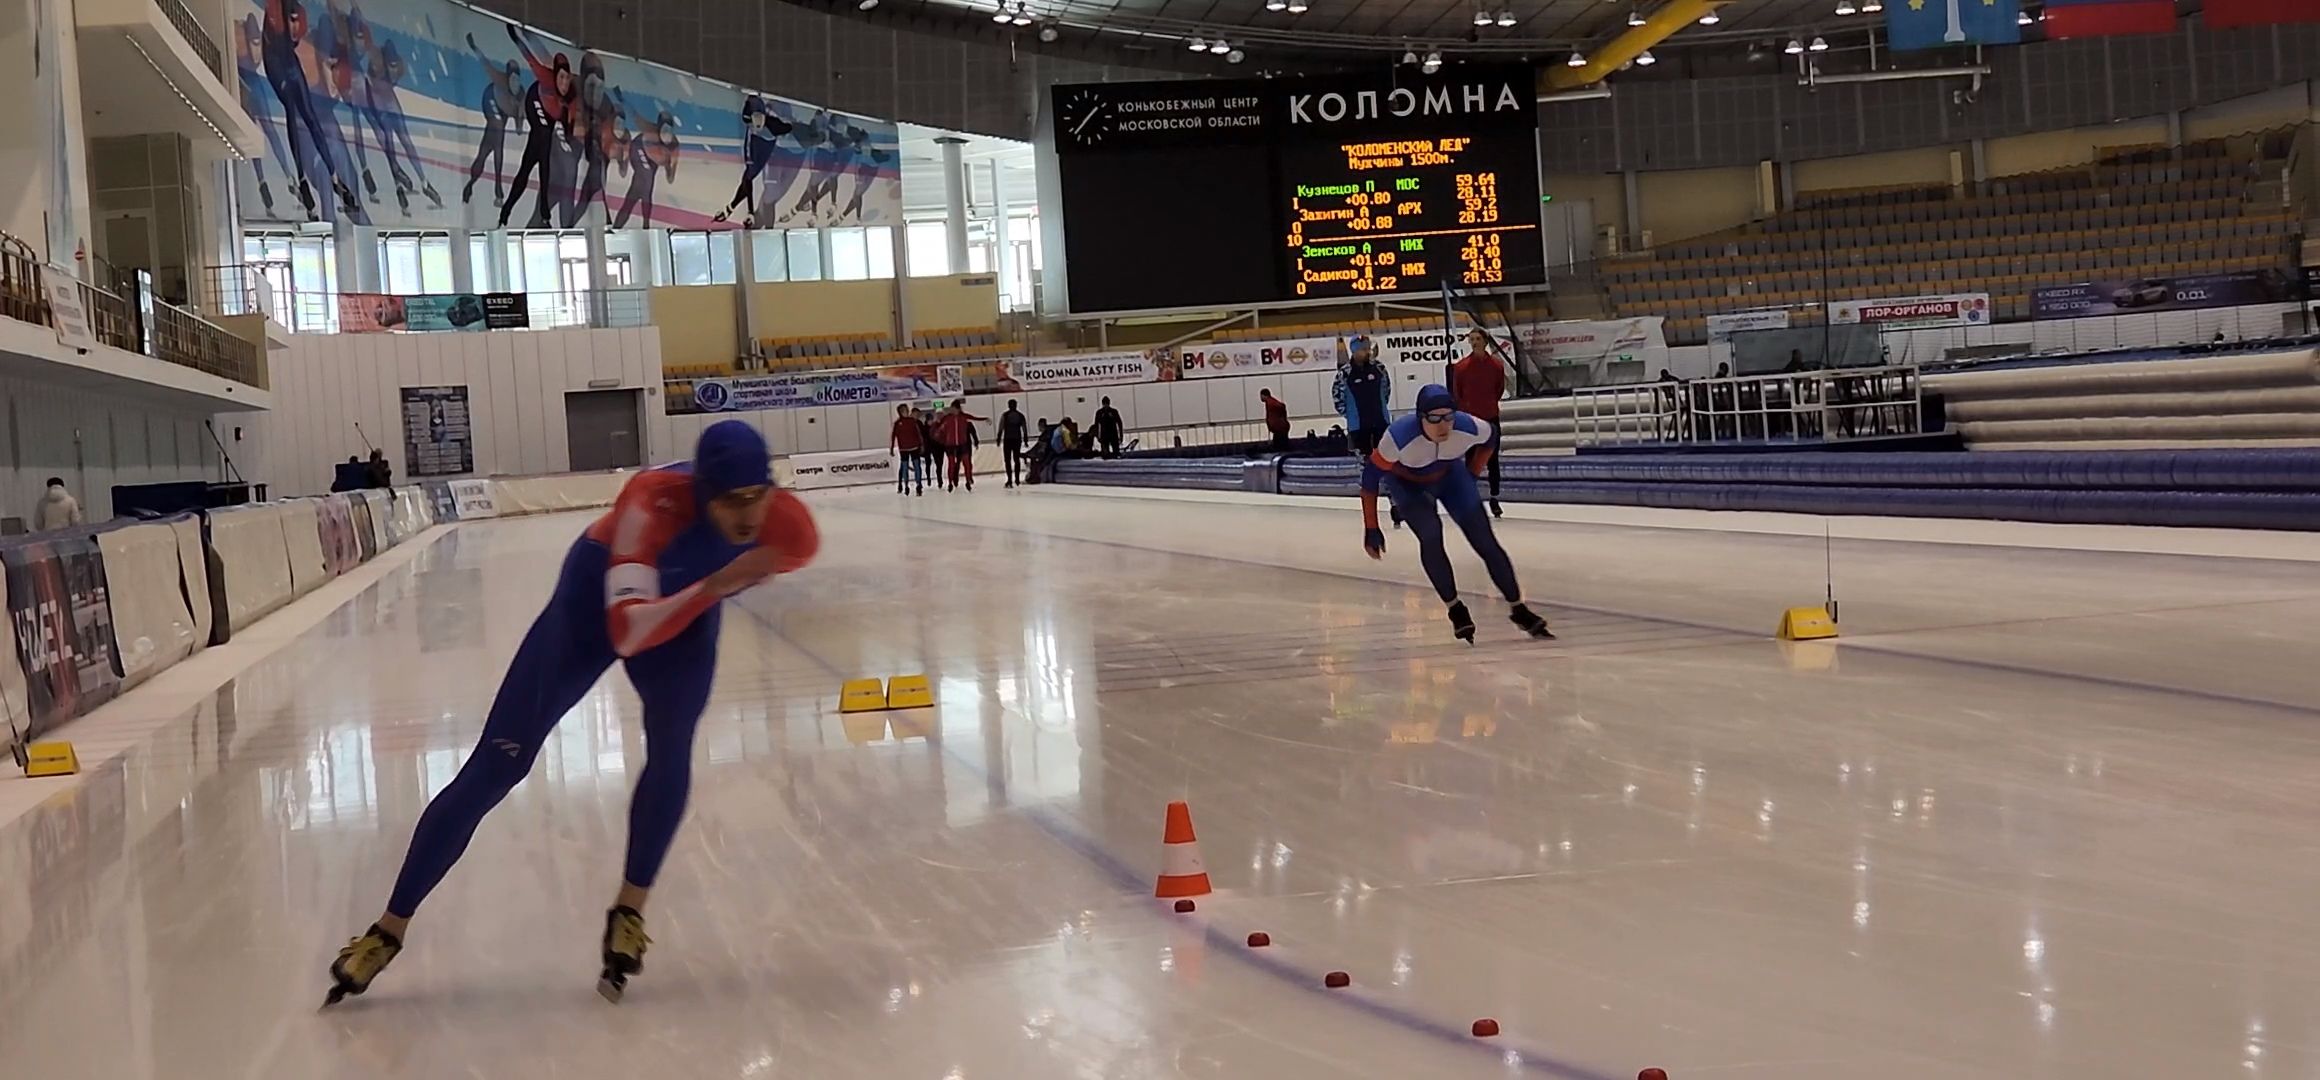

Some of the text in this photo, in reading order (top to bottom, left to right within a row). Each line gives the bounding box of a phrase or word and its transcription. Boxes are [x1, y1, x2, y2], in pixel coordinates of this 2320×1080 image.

[1117, 97, 1259, 113] КОНЬКОБЕЖНЫЙ ЦЕНТР
[1290, 83, 1520, 124] КОЛОМНА
[1118, 115, 1261, 131] МОСКОВСКОЙ ОБЛАСТИ
[1349, 154, 1455, 170] Мужчины 1500м.
[1297, 173, 1496, 197] Кузнецов П МОС 59.64
[1457, 186, 1496, 199] 28.11
[1299, 208, 1354, 222] Зажигин
[1465, 198, 1497, 211] 59.2
[1458, 210, 1498, 223] 28.19
[1287, 234, 1303, 247] 10
[1302, 245, 1356, 258] Земсков
[1400, 238, 1424, 252] НИХ
[1467, 234, 1500, 247] 41.0
[1349, 252, 1395, 267] +01.09
[1461, 246, 1501, 260] 28.40
[1303, 270, 1358, 283] Садиков
[1469, 258, 1502, 271] 41.0
[1351, 276, 1398, 291] +01.22
[1463, 270, 1503, 284] 28.53
[1866, 303, 1953, 318] ЛОР-ОРГАНОВ
[1025, 367, 1080, 381] KOLOMNA
[1082, 364, 1115, 376] TASTY
[1117, 363, 1143, 374] FISH
[816, 385, 879, 402] «Комета»
[795, 459, 891, 476] смотри СПОРТИВНЫЙ
